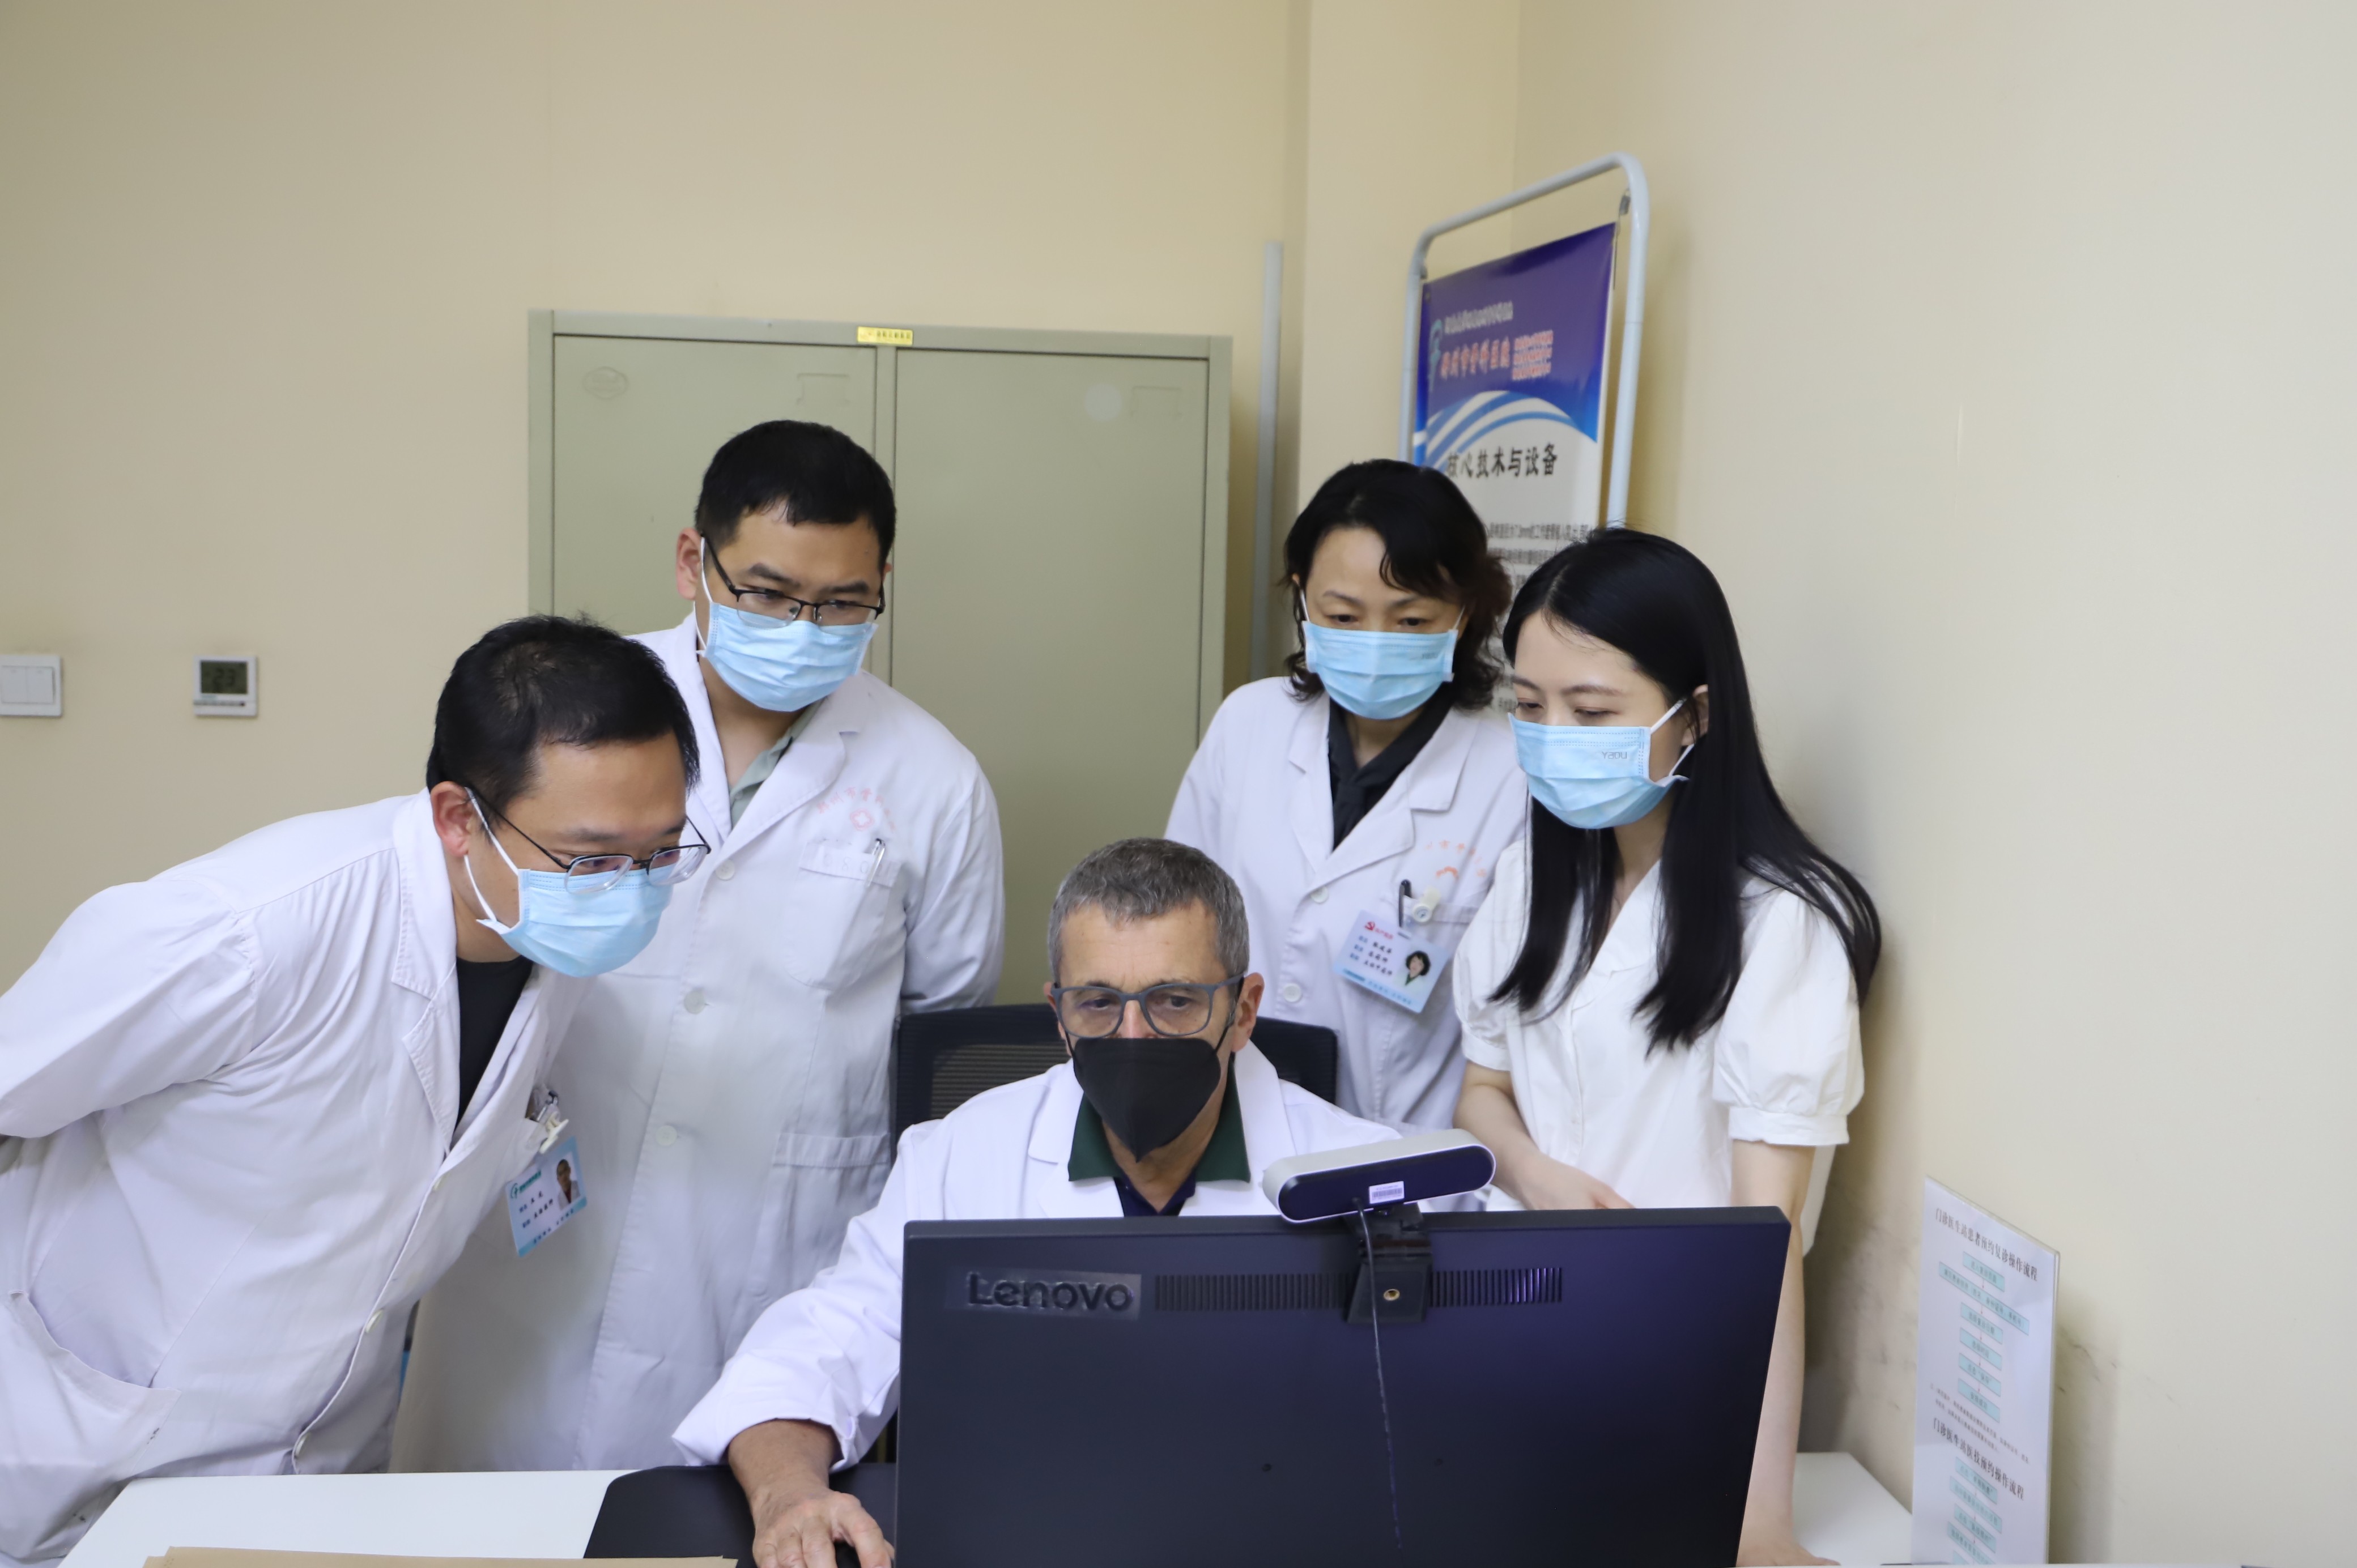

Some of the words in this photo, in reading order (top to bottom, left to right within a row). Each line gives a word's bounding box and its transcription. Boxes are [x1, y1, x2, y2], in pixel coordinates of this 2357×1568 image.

[1935, 1208, 2038, 1281] 门诊医生站患者预约复诊操作流程
[968, 1272, 1134, 1311] Lenovo
[1934, 1417, 2024, 1501] 门诊医生站医技预约操作流程
